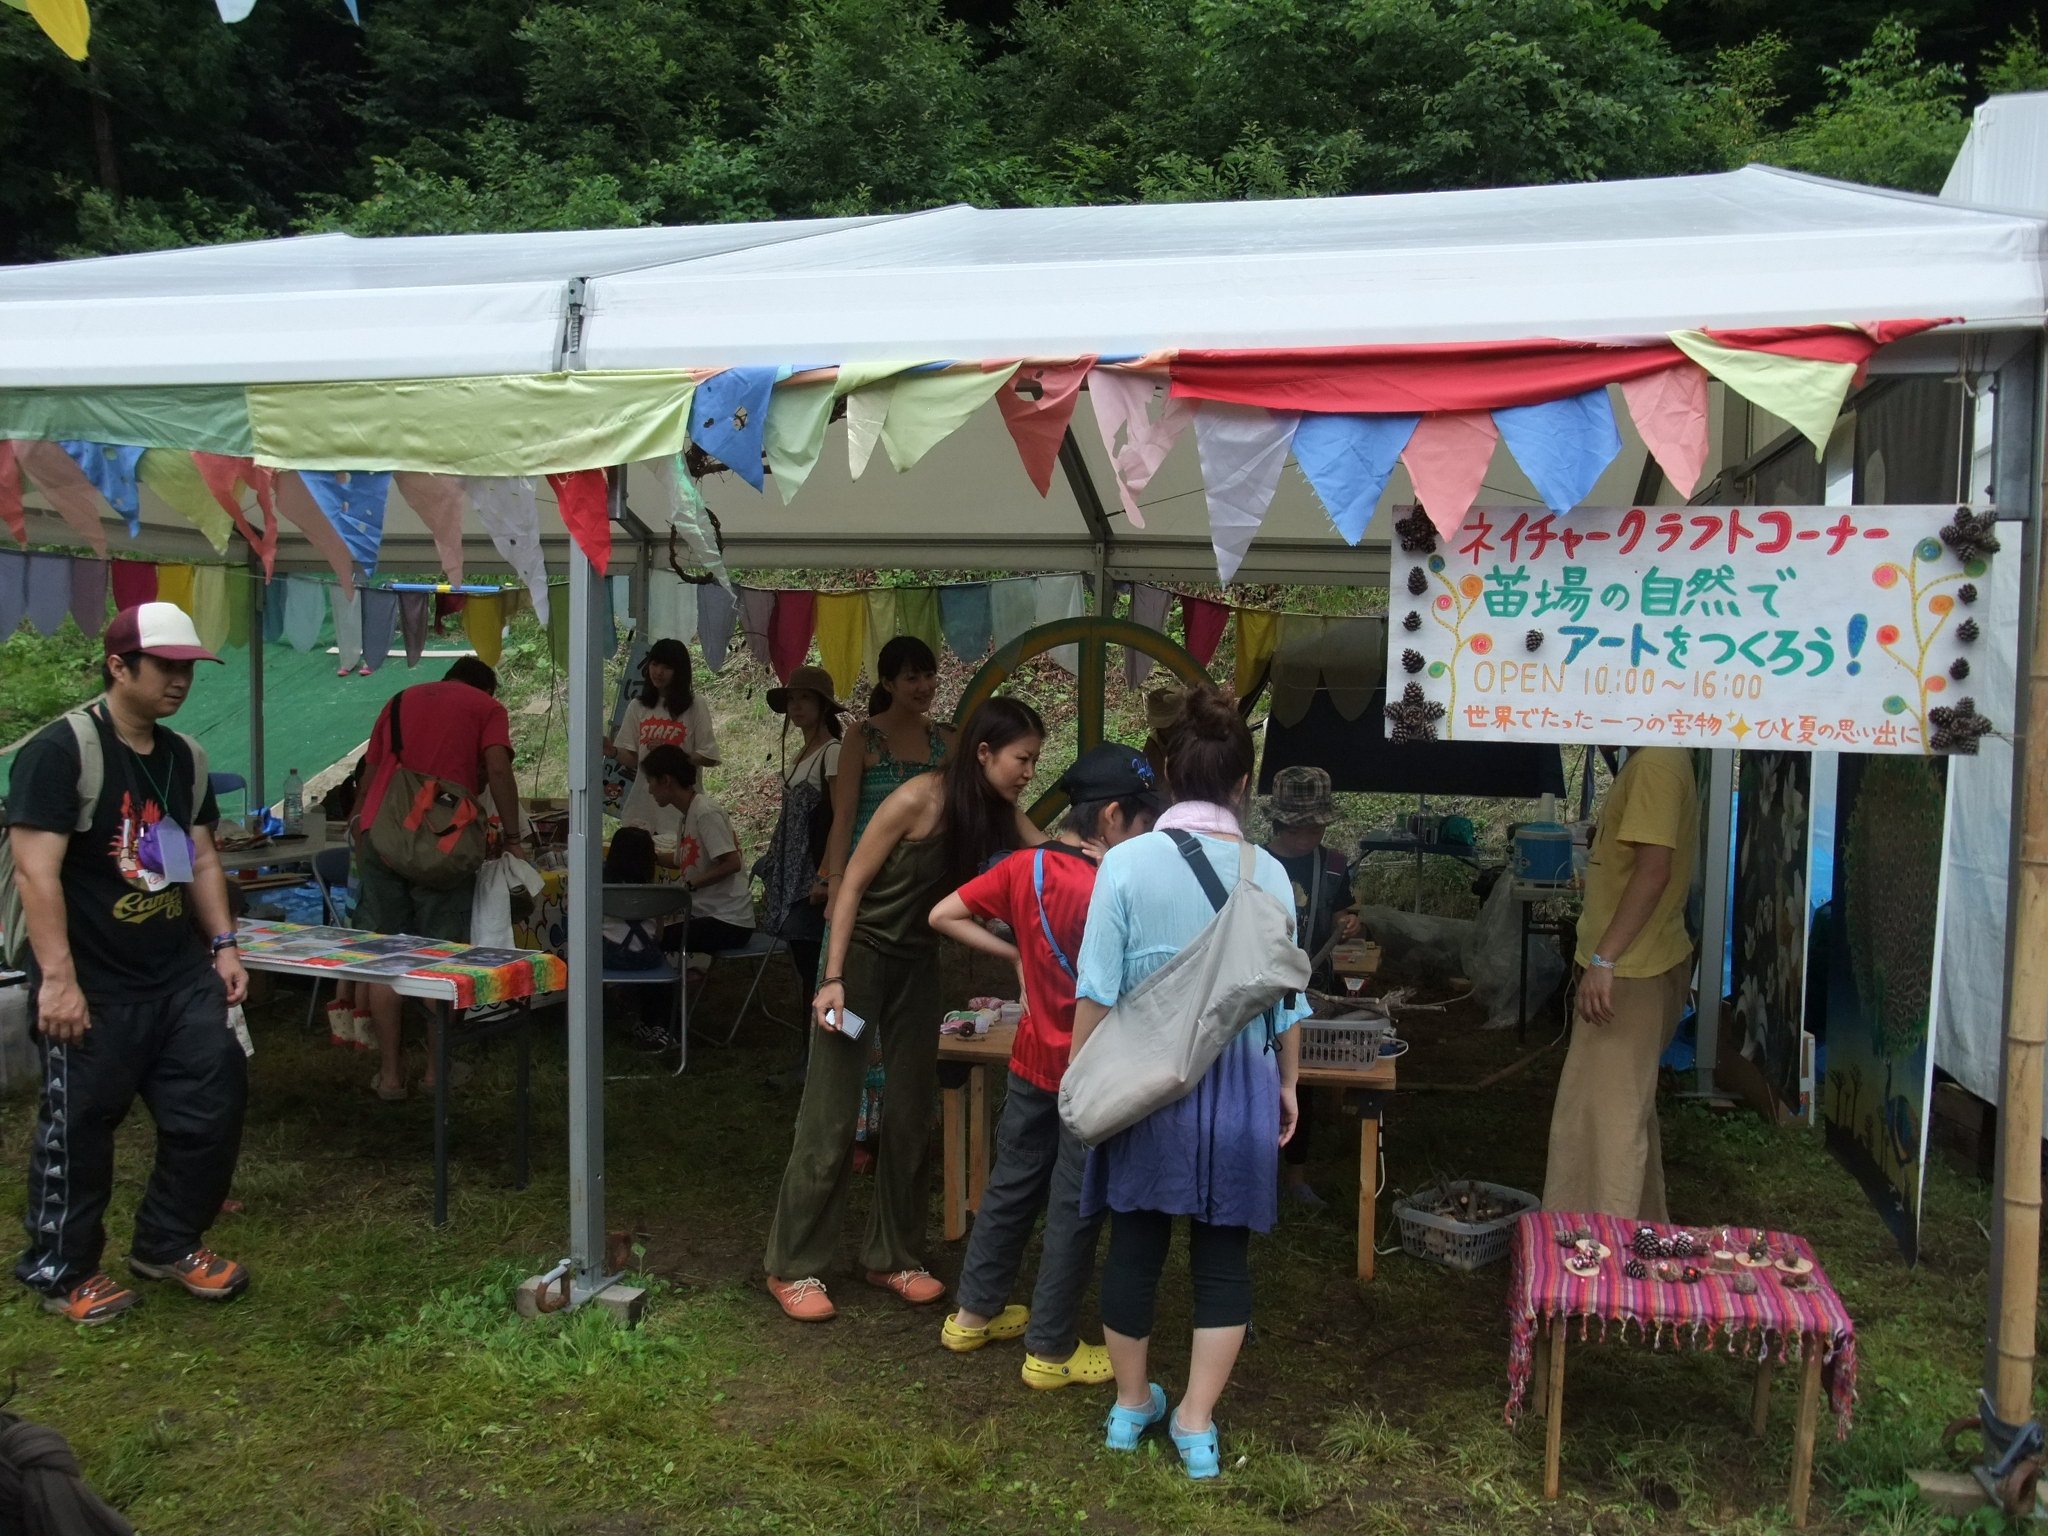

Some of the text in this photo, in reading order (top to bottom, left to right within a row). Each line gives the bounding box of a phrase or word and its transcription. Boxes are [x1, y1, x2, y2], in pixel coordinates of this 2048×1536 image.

[1459, 509, 1889, 565] ネイチャークラフトコーナー
[1482, 564, 1797, 623] 苗場の自然で
[1473, 660, 1567, 694] OPEN
[640, 724, 683, 743] STAFF
[1754, 714, 1921, 747] ひと夏の思い出に
